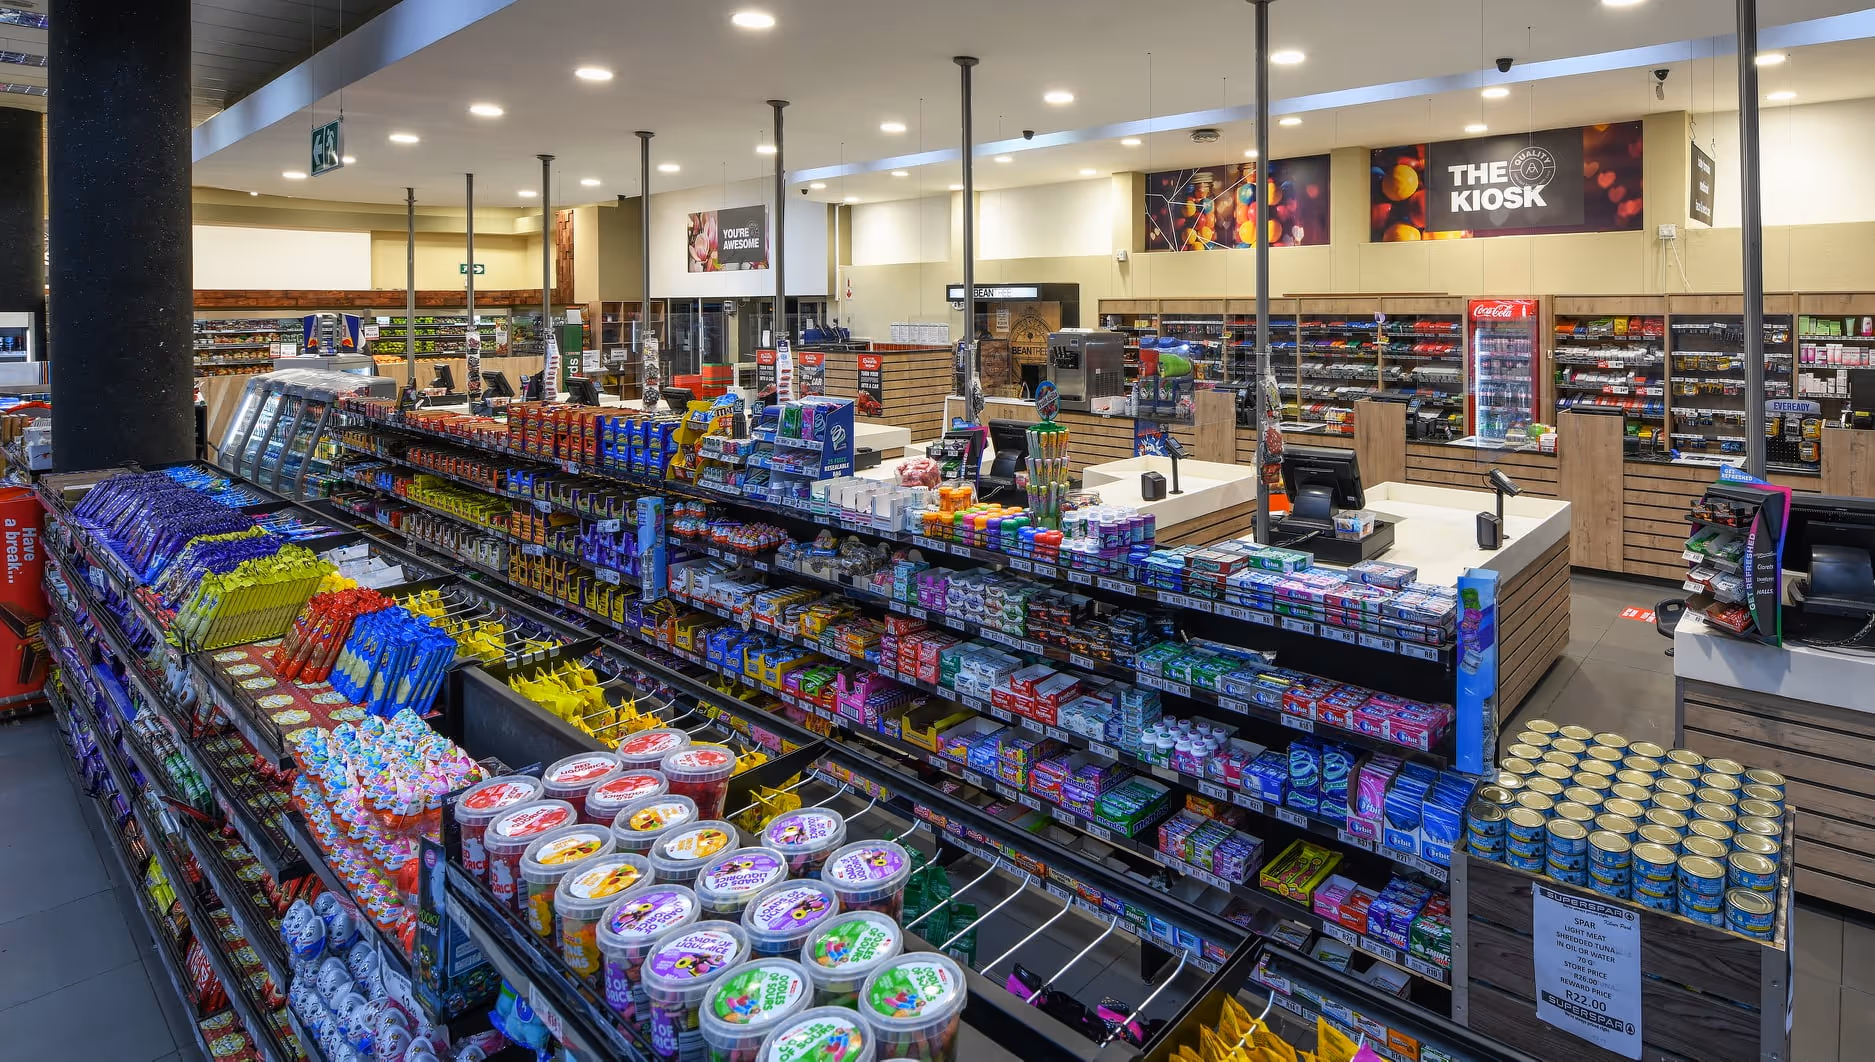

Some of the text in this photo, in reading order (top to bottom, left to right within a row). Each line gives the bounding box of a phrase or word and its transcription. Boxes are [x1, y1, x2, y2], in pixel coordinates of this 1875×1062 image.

[1514, 150, 1551, 166] QUALITY
[1448, 161, 1508, 186] THE
[1451, 184, 1547, 212] KIOSK
[723, 227, 749, 238] YOU'RE
[723, 238, 759, 250] AWESOME
[1474, 304, 1515, 317] Coca-Cola
[1773, 402, 1810, 411] EVEREADY
[824, 463, 849, 471] RESEALABLE
[5, 518, 17, 527] a
[22, 527, 37, 561] Have
[1746, 533, 1756, 610] GET REFRESHED
[1289, 702, 1308, 714] Orbit
[1324, 711, 1344, 723] Orbit
[1360, 720, 1380, 733] Orbit
[1397, 730, 1418, 744] Orbit
[938, 750, 965, 764] mentos
[560, 762, 606, 774] LIQUORICE
[969, 760, 995, 776] mentos
[1066, 775, 1097, 792] mentos
[1031, 786, 1060, 802] mentos
[1061, 800, 1094, 817] mentos
[512, 814, 530, 823] RED
[1097, 815, 1128, 834] mentos
[1133, 804, 1169, 833] mentos
[1350, 820, 1373, 835] Orbit
[1389, 831, 1412, 848] Orbit
[1426, 846, 1450, 861] Orbit
[714, 872, 767, 884] LIQUORICE
[731, 878, 765, 886] LOADS
[1546, 891, 1623, 918] SUPERSPAR
[1574, 918, 1596, 930] SPAR
[1564, 925, 1607, 941] LIGHT MEAT
[1556, 931, 1615, 954] SHREDDED TUNA
[1556, 940, 1616, 963] IN OIL OR WATER
[1577, 956, 1586, 964] 70
[1564, 960, 1608, 980] STORE PRICE
[1573, 973, 1598, 985] R26.00
[763, 972, 779, 1011] OF SOURS
[775, 975, 789, 1006] OODLES
[1560, 977, 1612, 999] REWARD PRICE
[1566, 989, 1607, 1012] R22.00
[1548, 995, 1623, 1032] SUPERSPAR
[797, 1024, 836, 1048] SOURS
